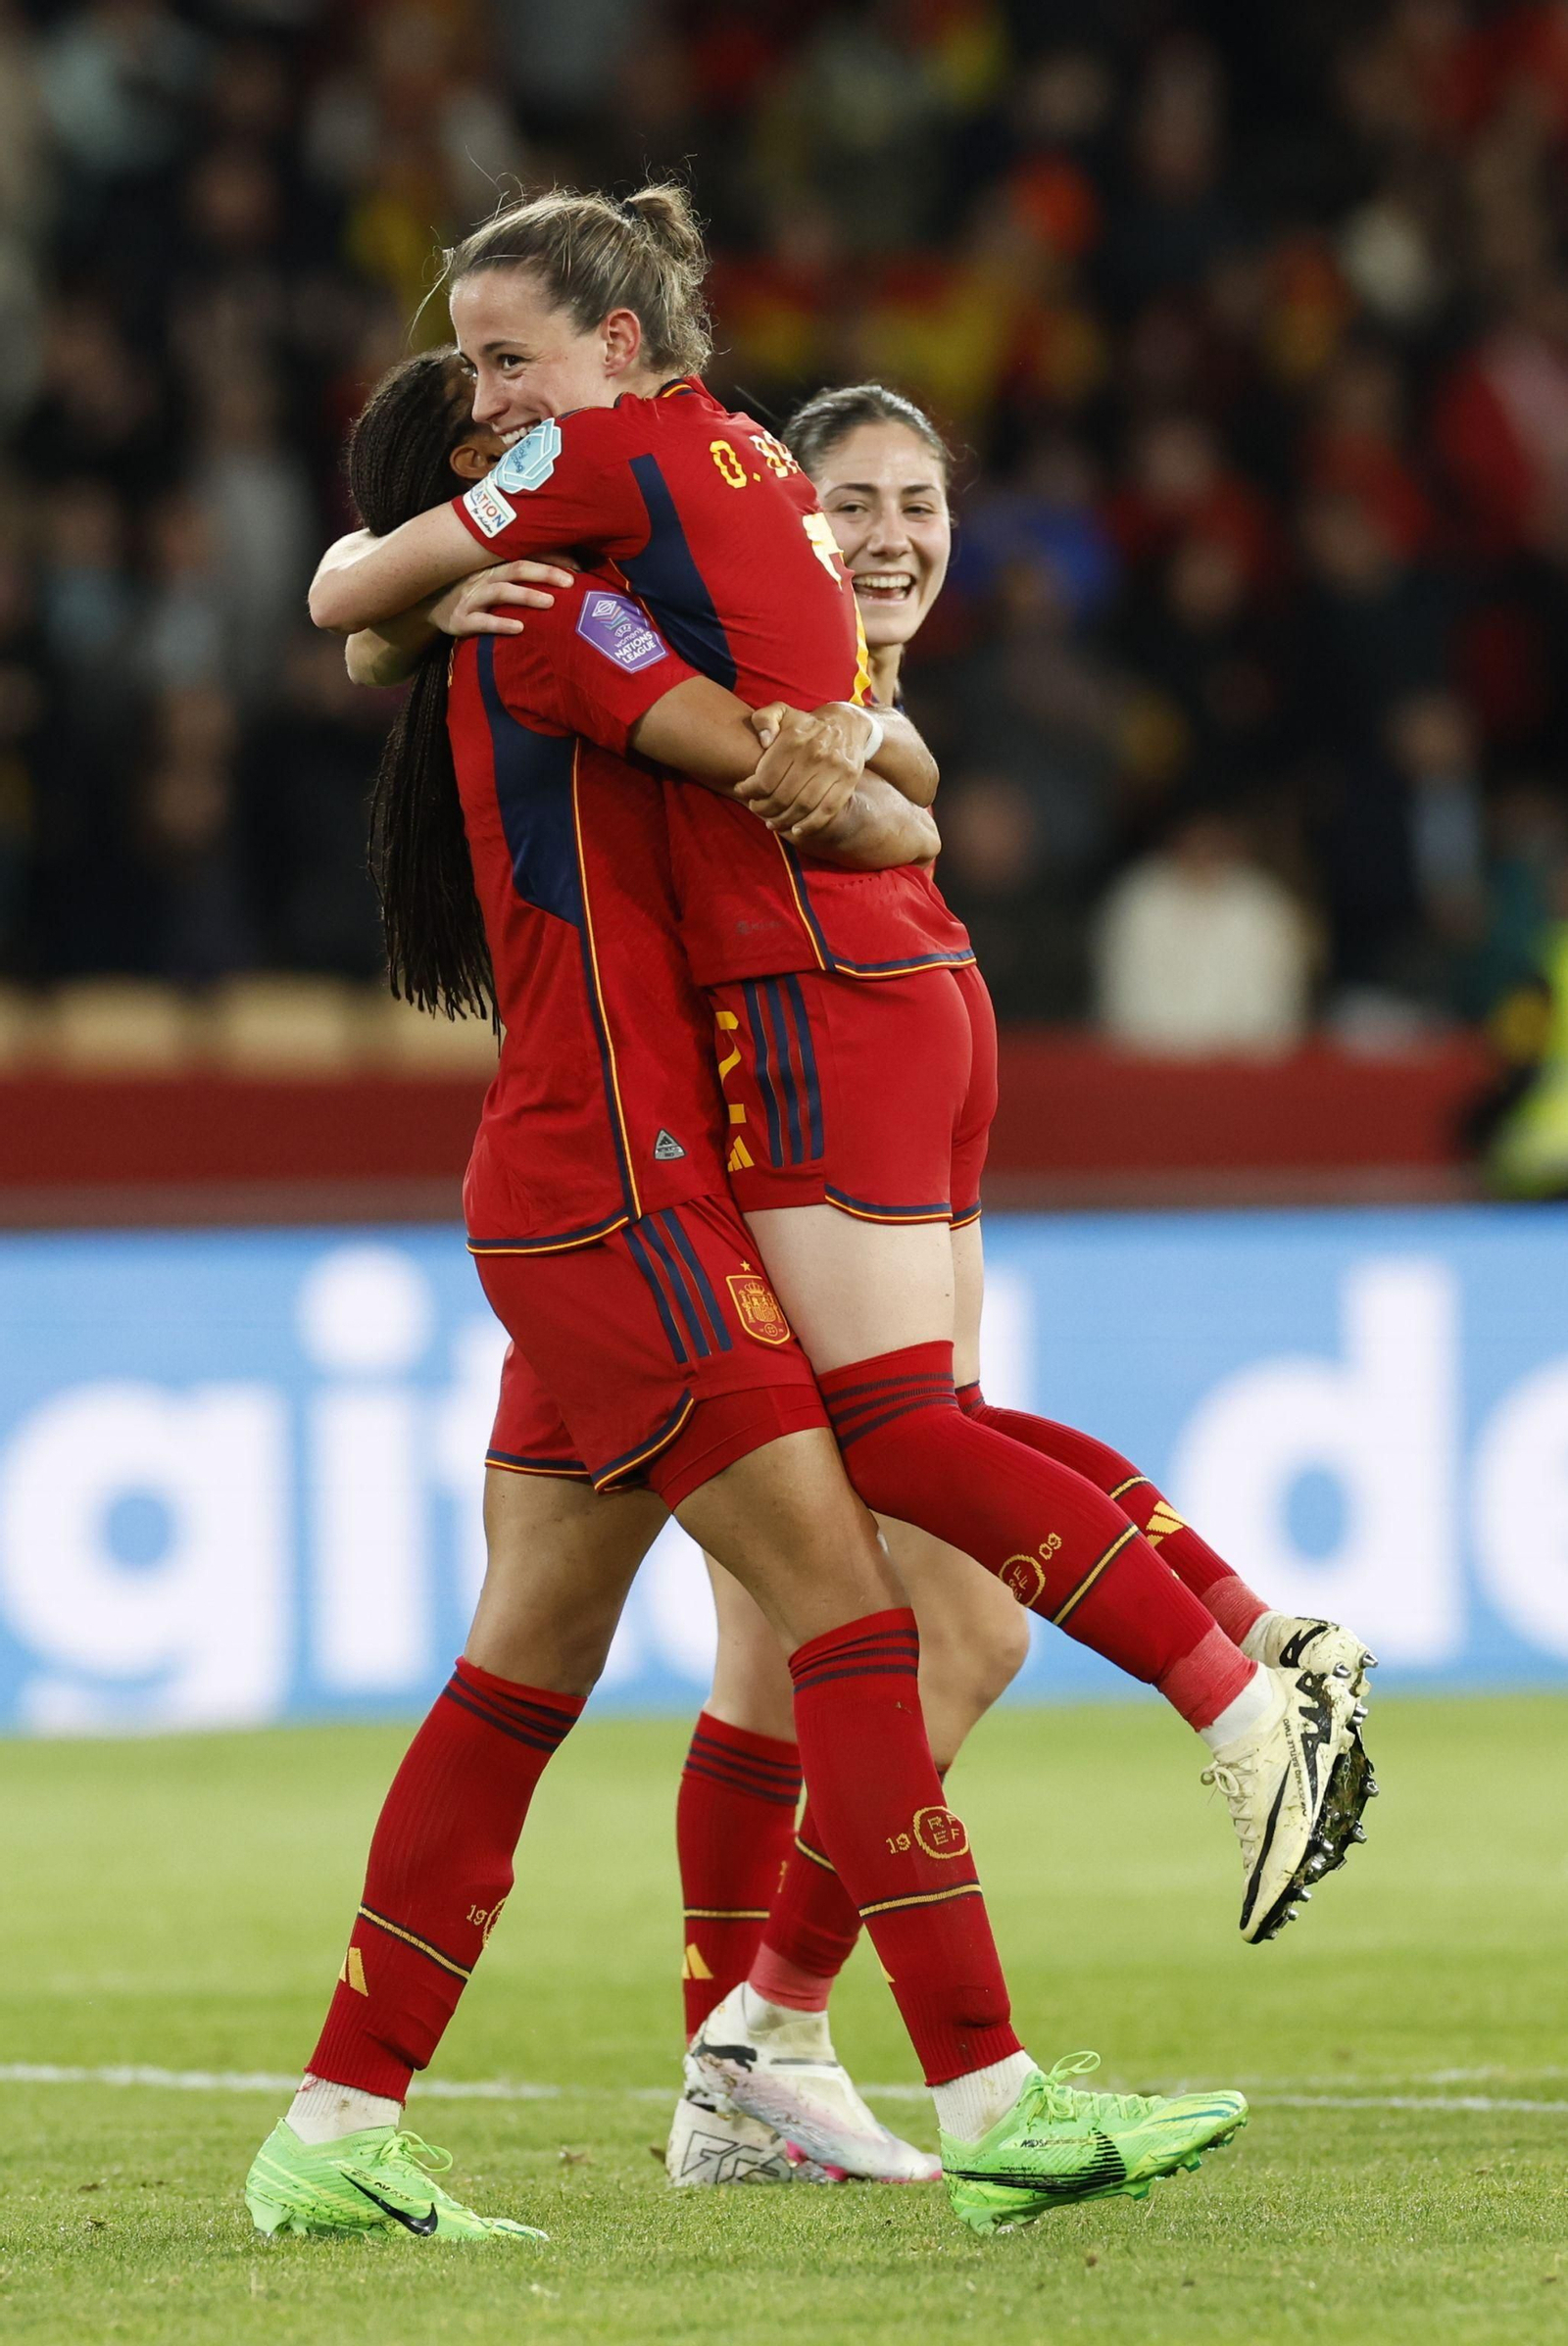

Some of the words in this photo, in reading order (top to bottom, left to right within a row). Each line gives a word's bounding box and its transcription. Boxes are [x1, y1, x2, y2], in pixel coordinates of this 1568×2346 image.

[710, 440, 761, 489] O.
[614, 631, 654, 659] NATIONS
[622, 641, 657, 663] LEAGUE
[1039, 1532, 1062, 1560] 09
[885, 1833, 911, 1855] 19
[466, 1904, 488, 1927] 19
